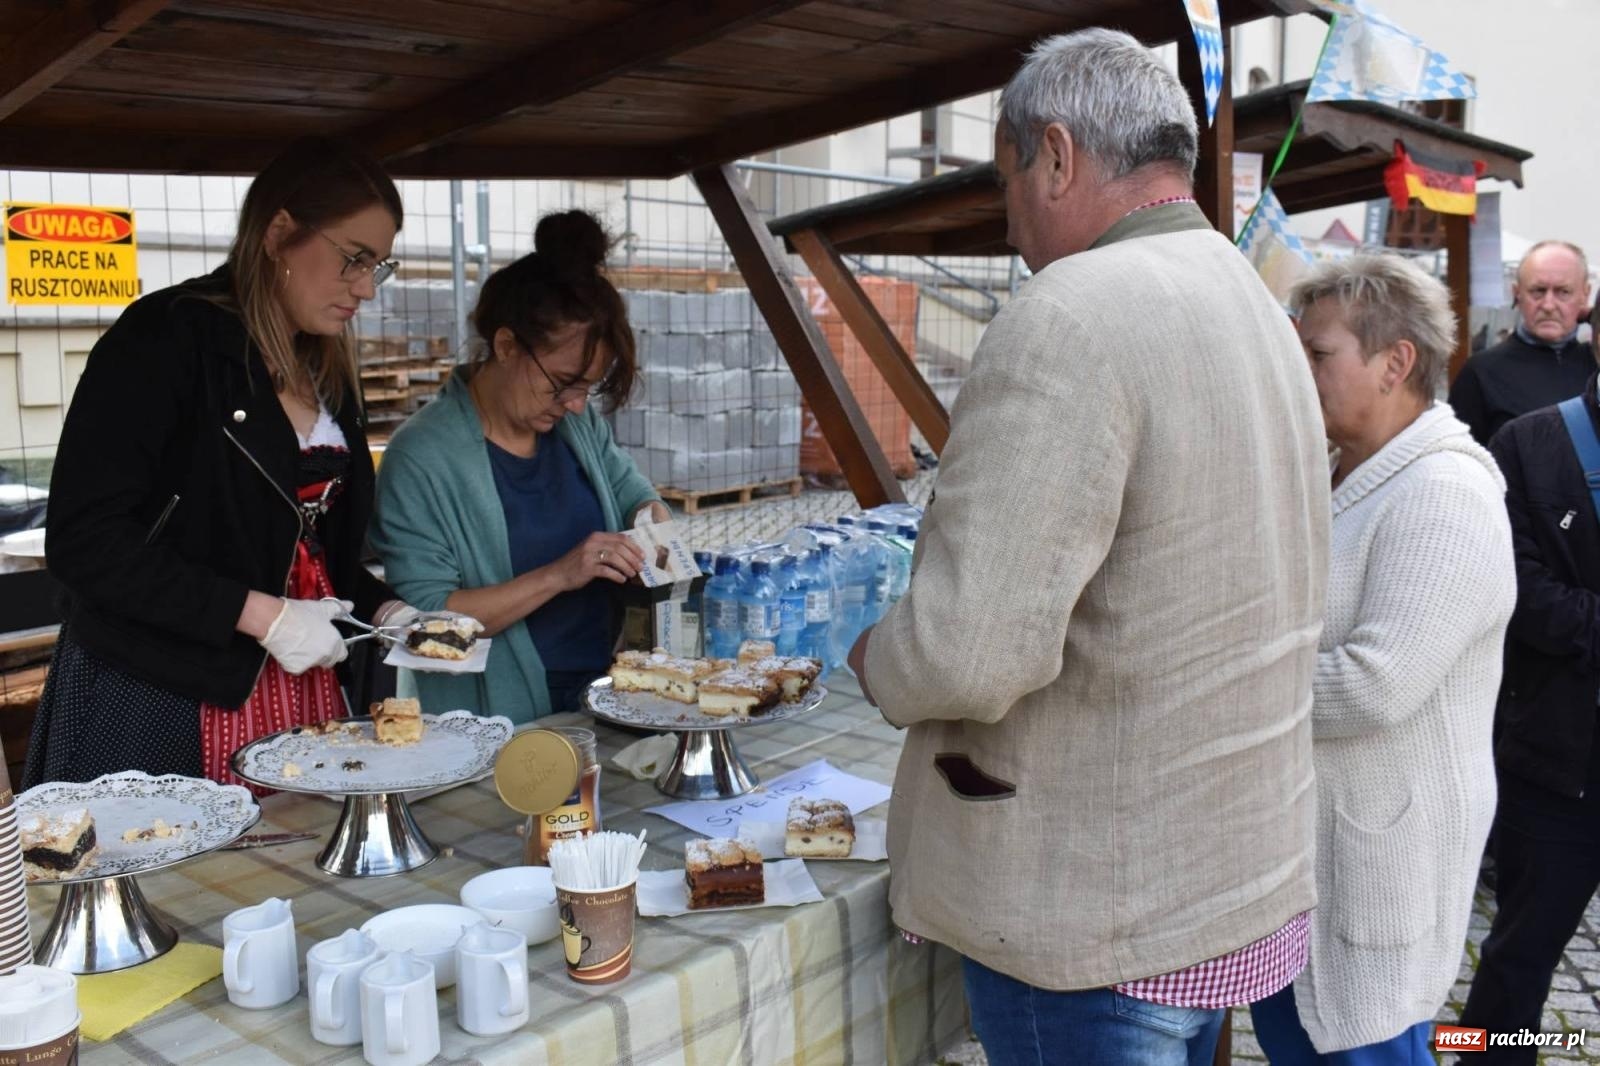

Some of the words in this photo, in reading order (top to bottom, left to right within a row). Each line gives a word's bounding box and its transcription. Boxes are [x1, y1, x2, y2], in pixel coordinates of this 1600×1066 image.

[24, 213, 117, 238] UWAGA
[30, 249, 90, 270] PRACE
[95, 251, 118, 270] NA
[10, 278, 135, 298] RUSZTOWANIU
[706, 778, 828, 827] SPENDE
[545, 810, 590, 825] GOLD
[585, 893, 628, 906] Chocolate
[25, 1046, 62, 1063] Lungo
